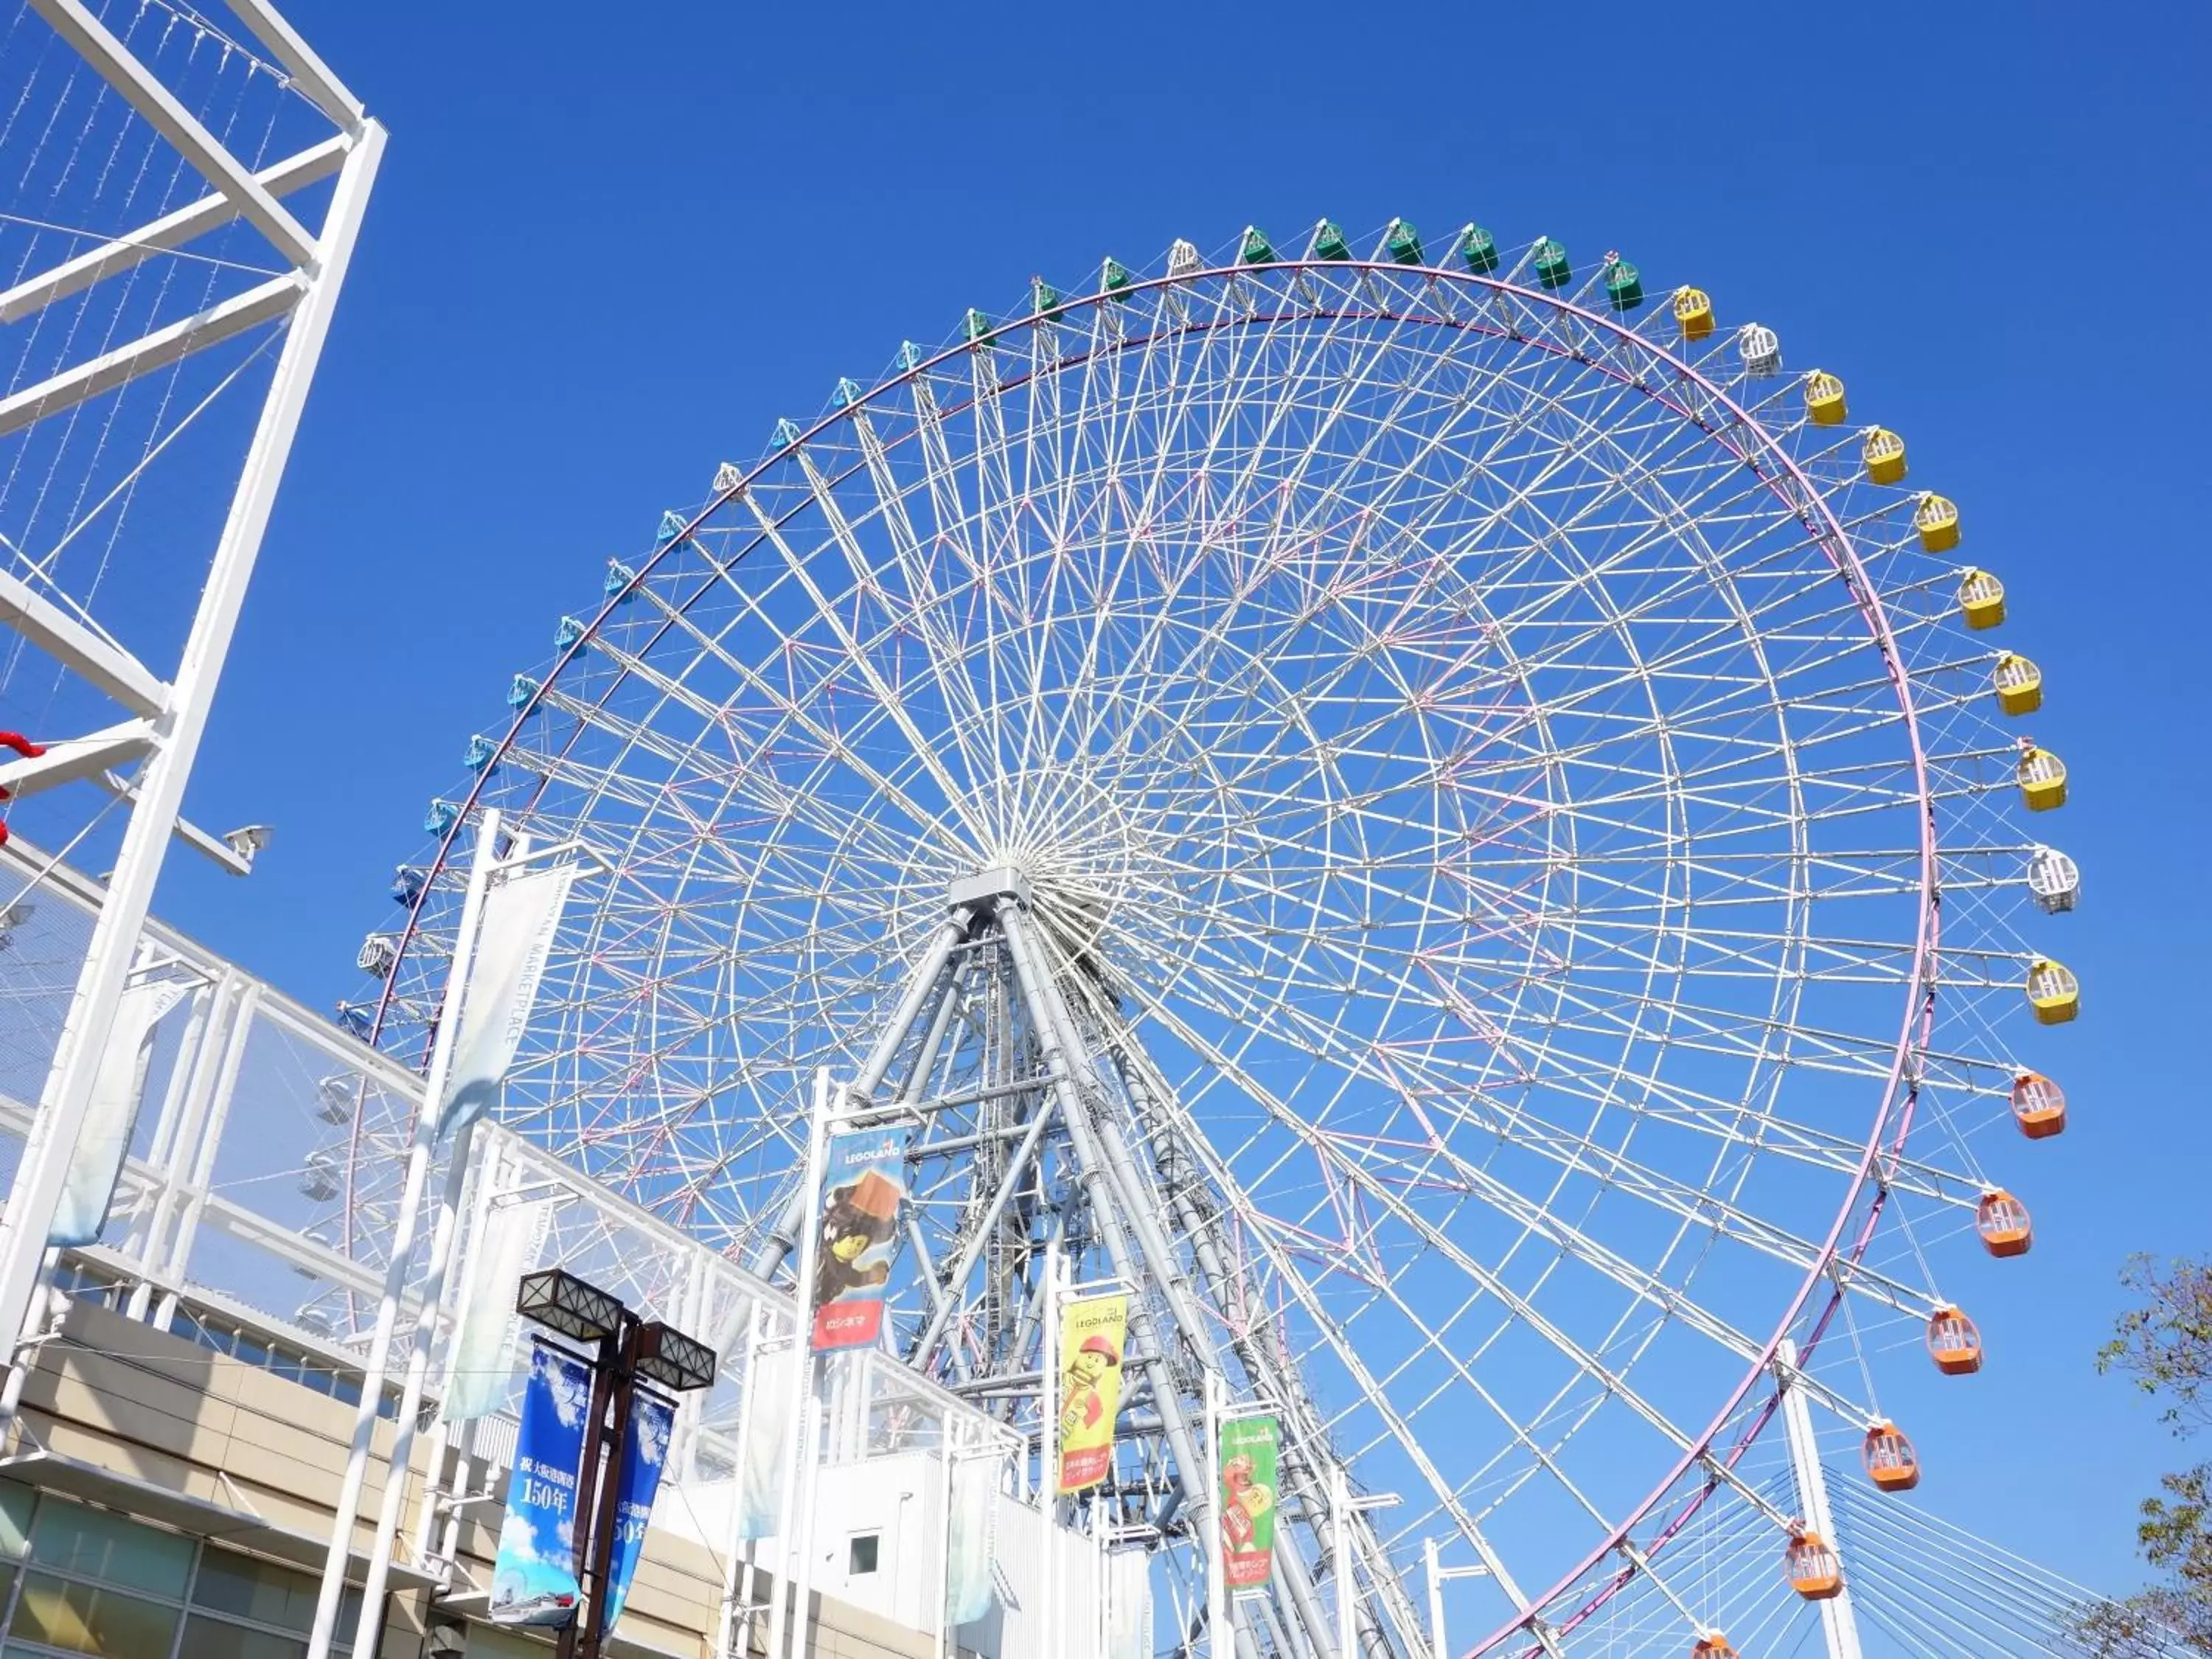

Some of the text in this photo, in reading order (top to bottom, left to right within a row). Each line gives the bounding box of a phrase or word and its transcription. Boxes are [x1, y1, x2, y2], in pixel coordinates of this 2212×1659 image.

[506, 944, 545, 1045] MARKETPLACE
[845, 1144, 900, 1165] LEGOLAND
[1076, 1312, 1123, 1328] LEGOLAND
[520, 1478, 568, 1515] 150年
